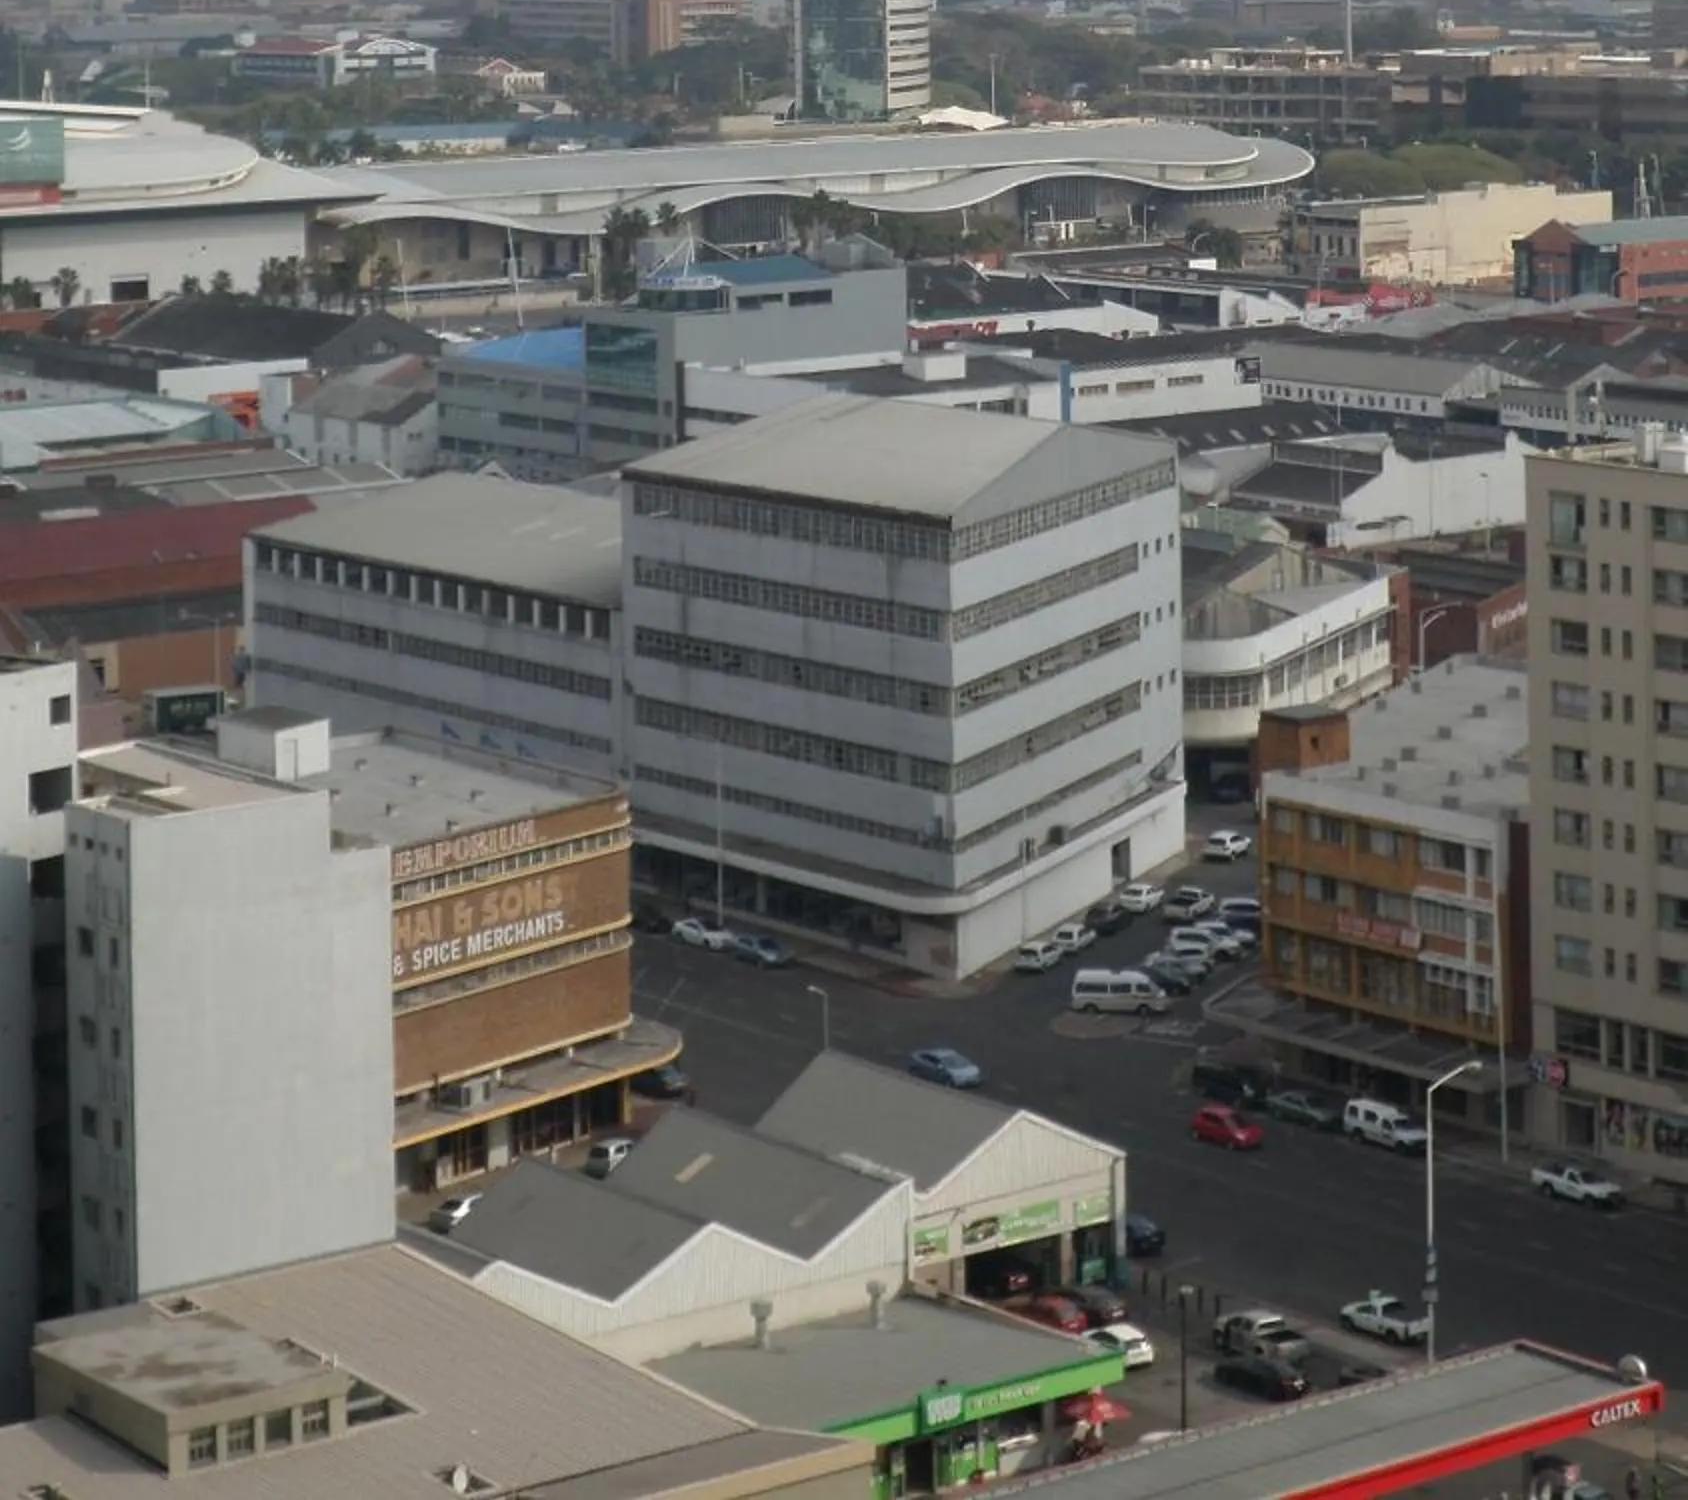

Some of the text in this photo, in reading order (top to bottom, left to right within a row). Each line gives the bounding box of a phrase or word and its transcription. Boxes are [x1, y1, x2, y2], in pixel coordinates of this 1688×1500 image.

[394, 819, 536, 877] EMPORIUM
[453, 900, 473, 932] &
[481, 874, 563, 926] SONS
[393, 911, 565, 976] & SPICE MERCHANTS
[1591, 1399, 1641, 1427] CALTEX
